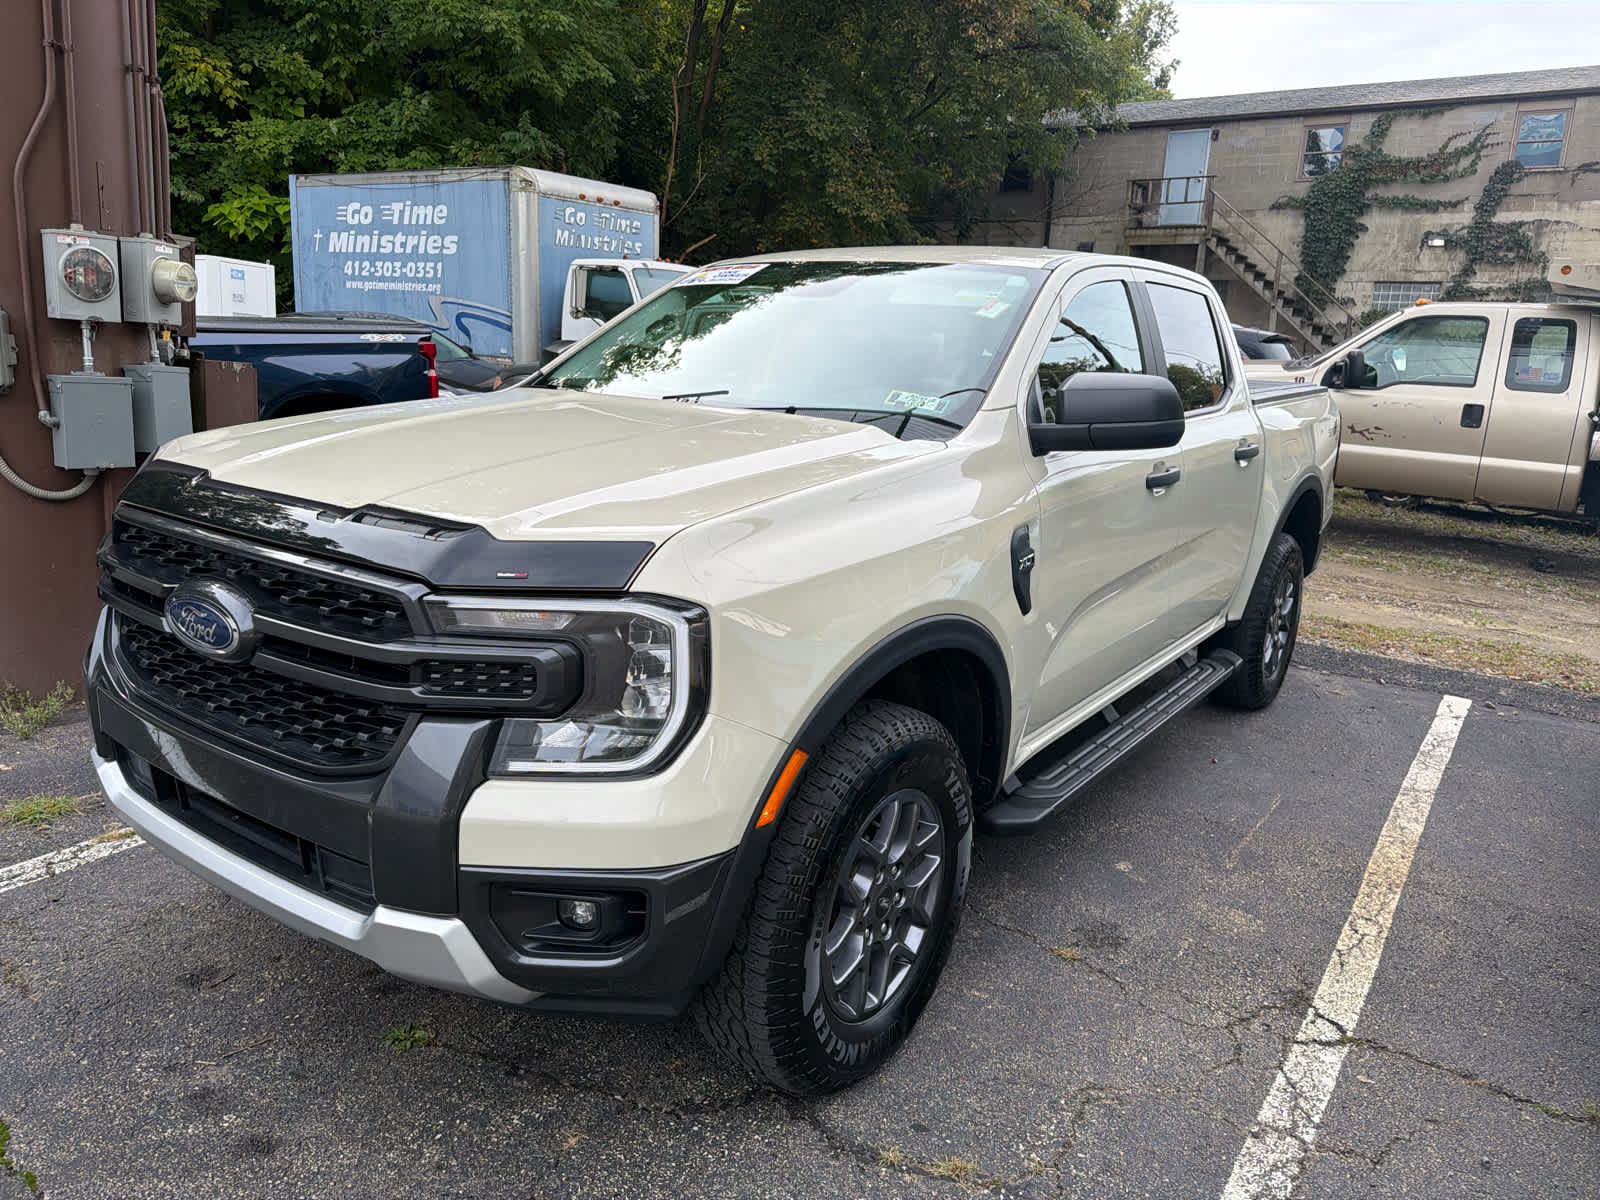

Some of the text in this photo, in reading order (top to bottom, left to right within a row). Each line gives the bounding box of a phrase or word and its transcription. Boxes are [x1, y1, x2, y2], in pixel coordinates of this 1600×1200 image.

[345, 200, 448, 225] Go Time
[564, 206, 641, 234] Go Time
[328, 229, 459, 255] Ministries
[553, 228, 643, 255] Ministries
[343, 260, 442, 278] 412-303-0351
[345, 280, 442, 295] www.gotimeministries.org
[181, 605, 217, 643] Ford
